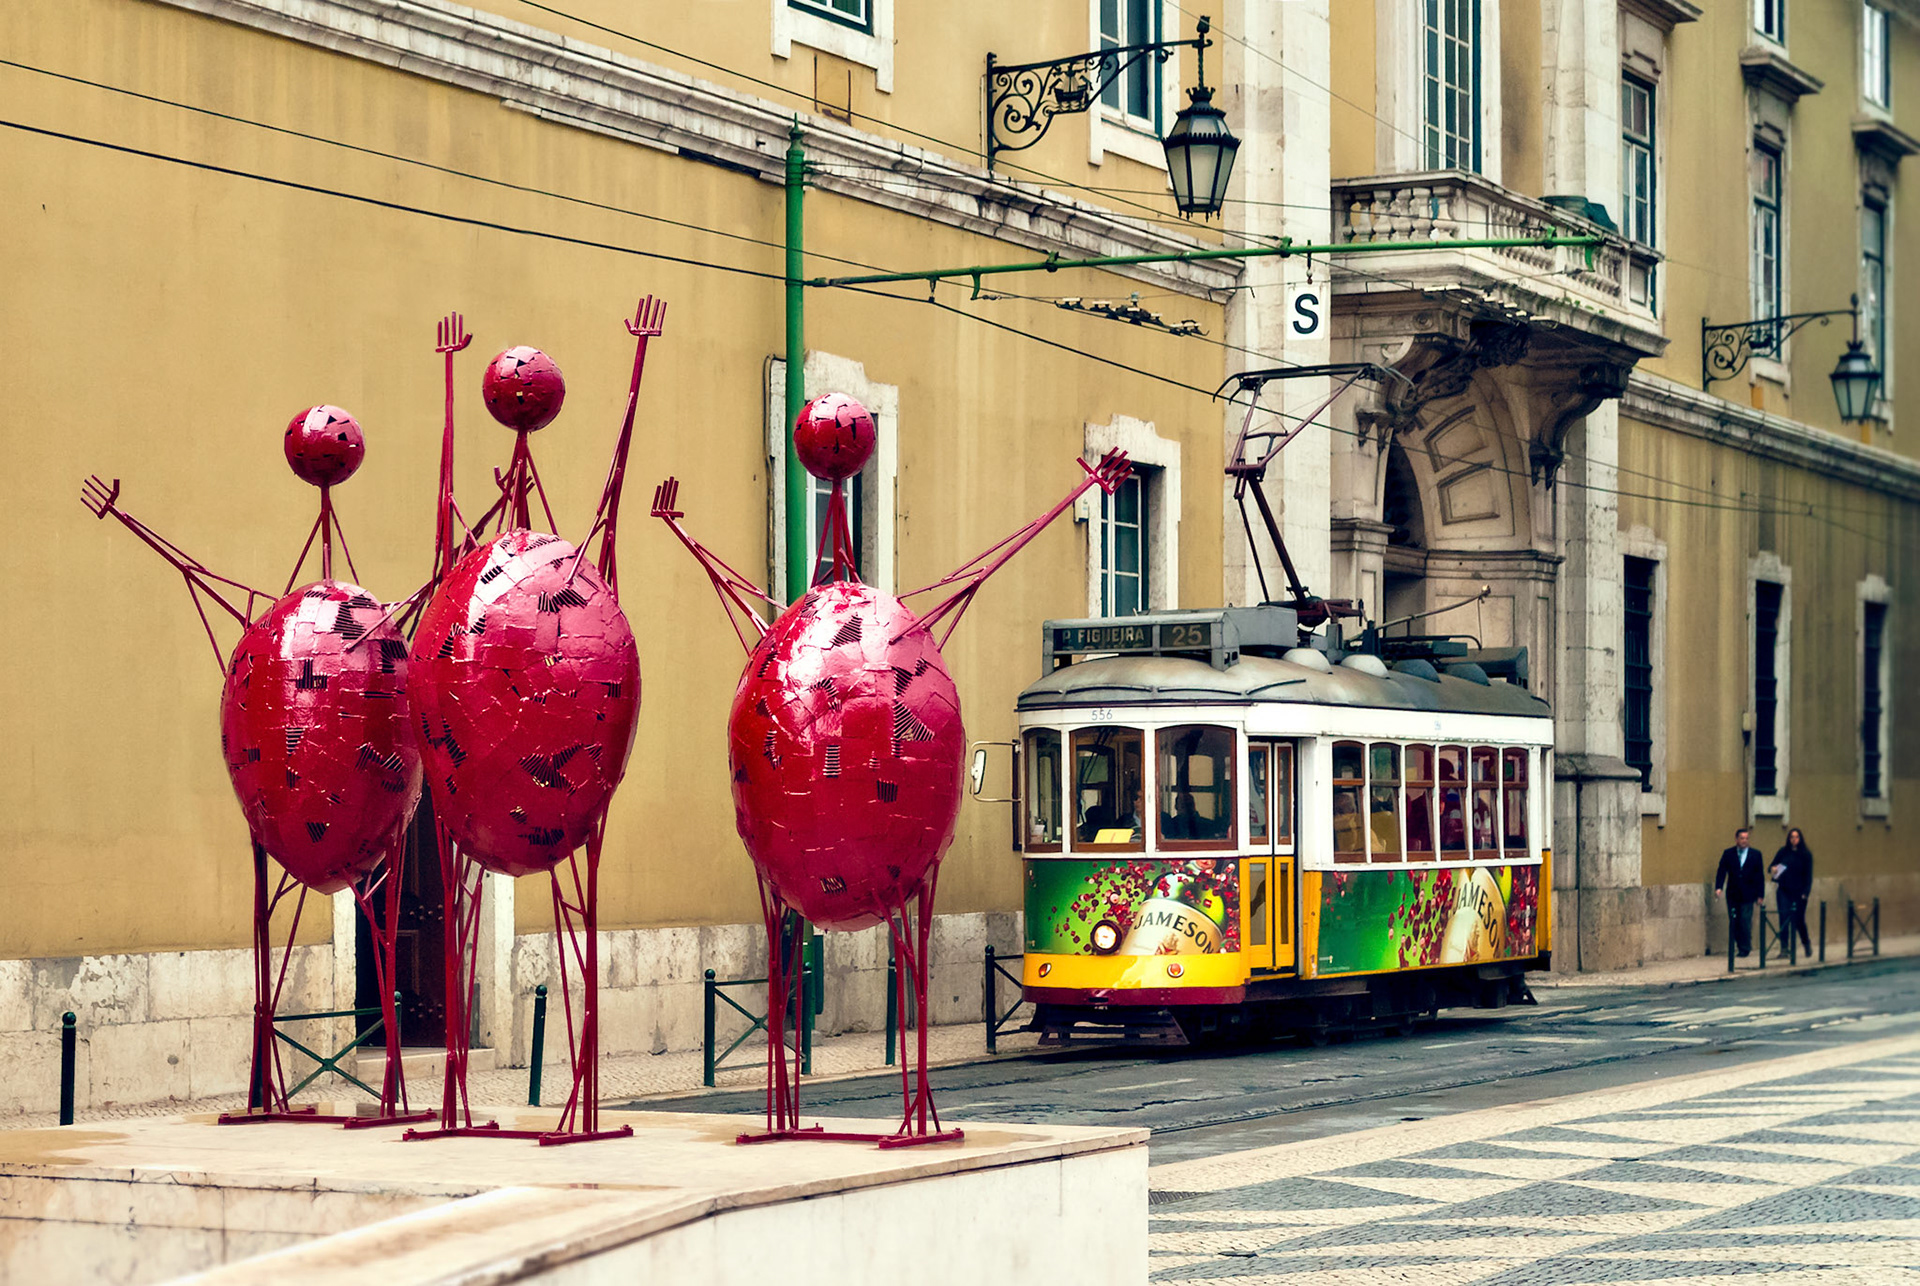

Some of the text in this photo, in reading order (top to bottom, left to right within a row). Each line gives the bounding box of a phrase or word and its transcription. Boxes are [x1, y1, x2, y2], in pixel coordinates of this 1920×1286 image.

[1293, 293, 1319, 335] S
[1077, 626, 1145, 644] FIGUEIRA
[1171, 624, 1203, 647] 25
[1091, 709, 1113, 721] 556
[1134, 911, 1214, 954] JAMESON
